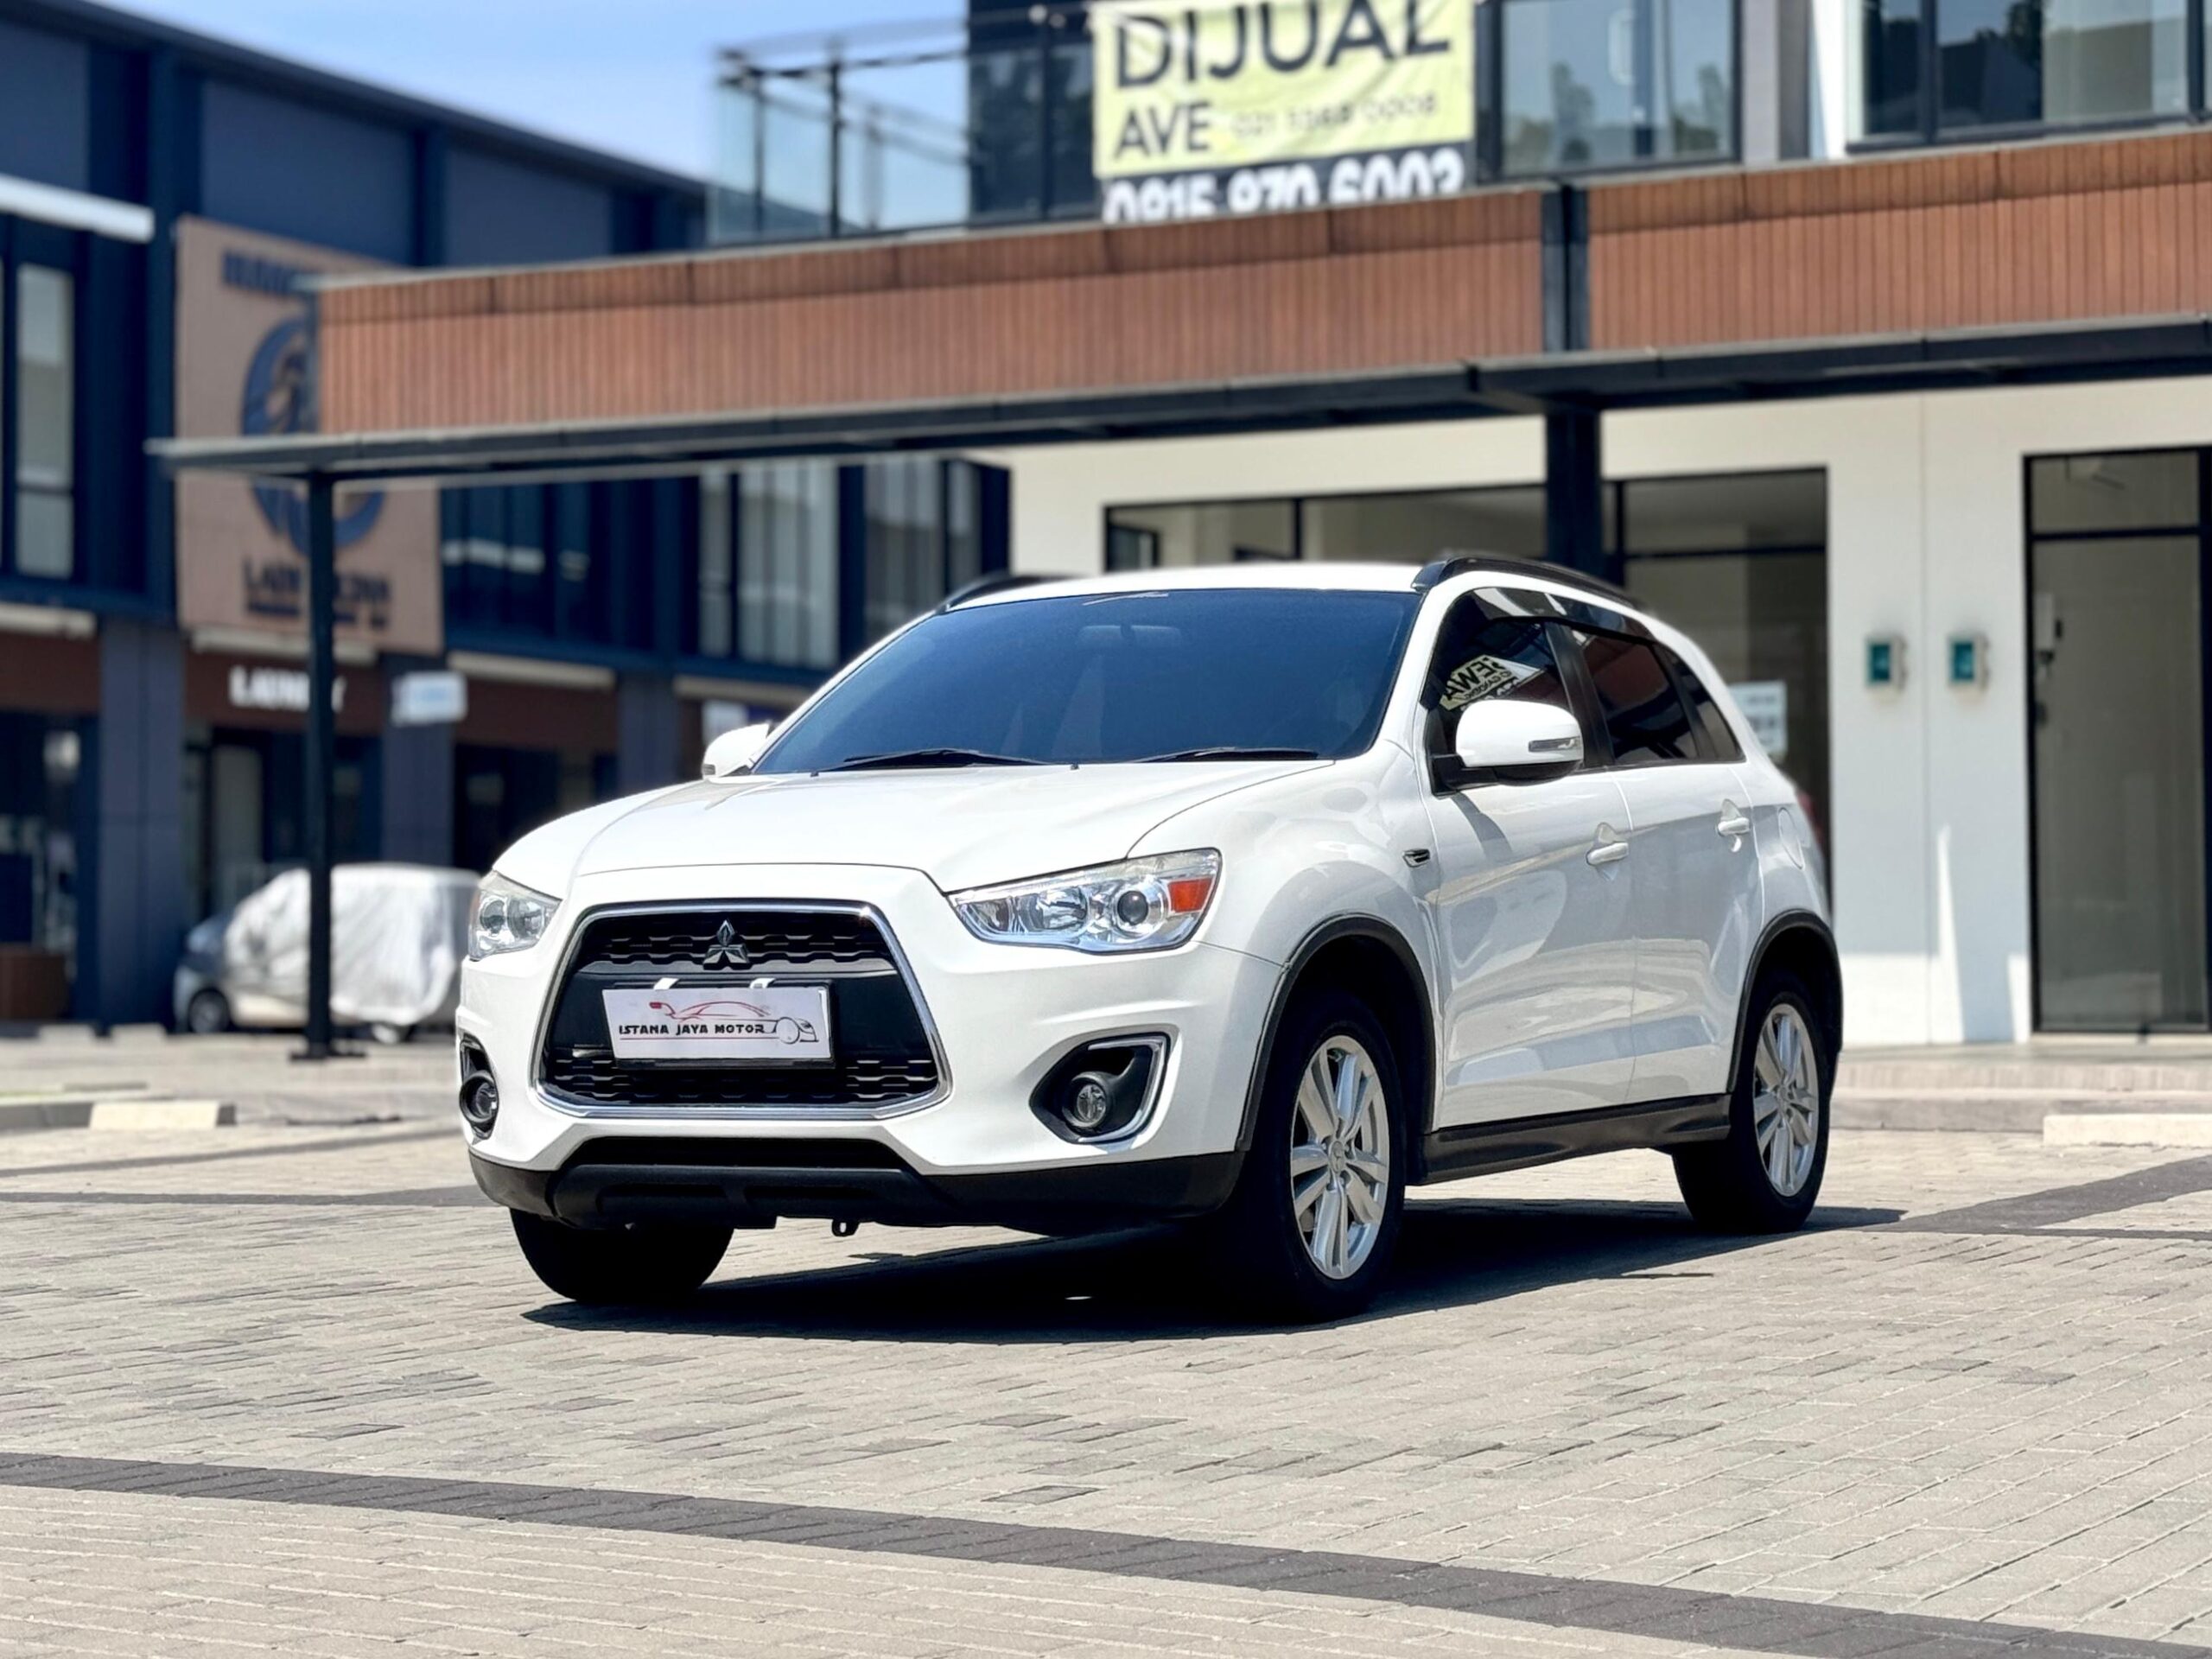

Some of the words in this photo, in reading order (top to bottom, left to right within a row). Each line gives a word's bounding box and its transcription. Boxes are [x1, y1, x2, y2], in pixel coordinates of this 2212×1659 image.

[1116, 0, 1450, 89] DIJUAL
[1116, 101, 1211, 159] AVE
[619, 1025, 669, 1035] ISTANA
[676, 1024, 708, 1036] JAYA
[715, 1024, 765, 1034] MOTOR
